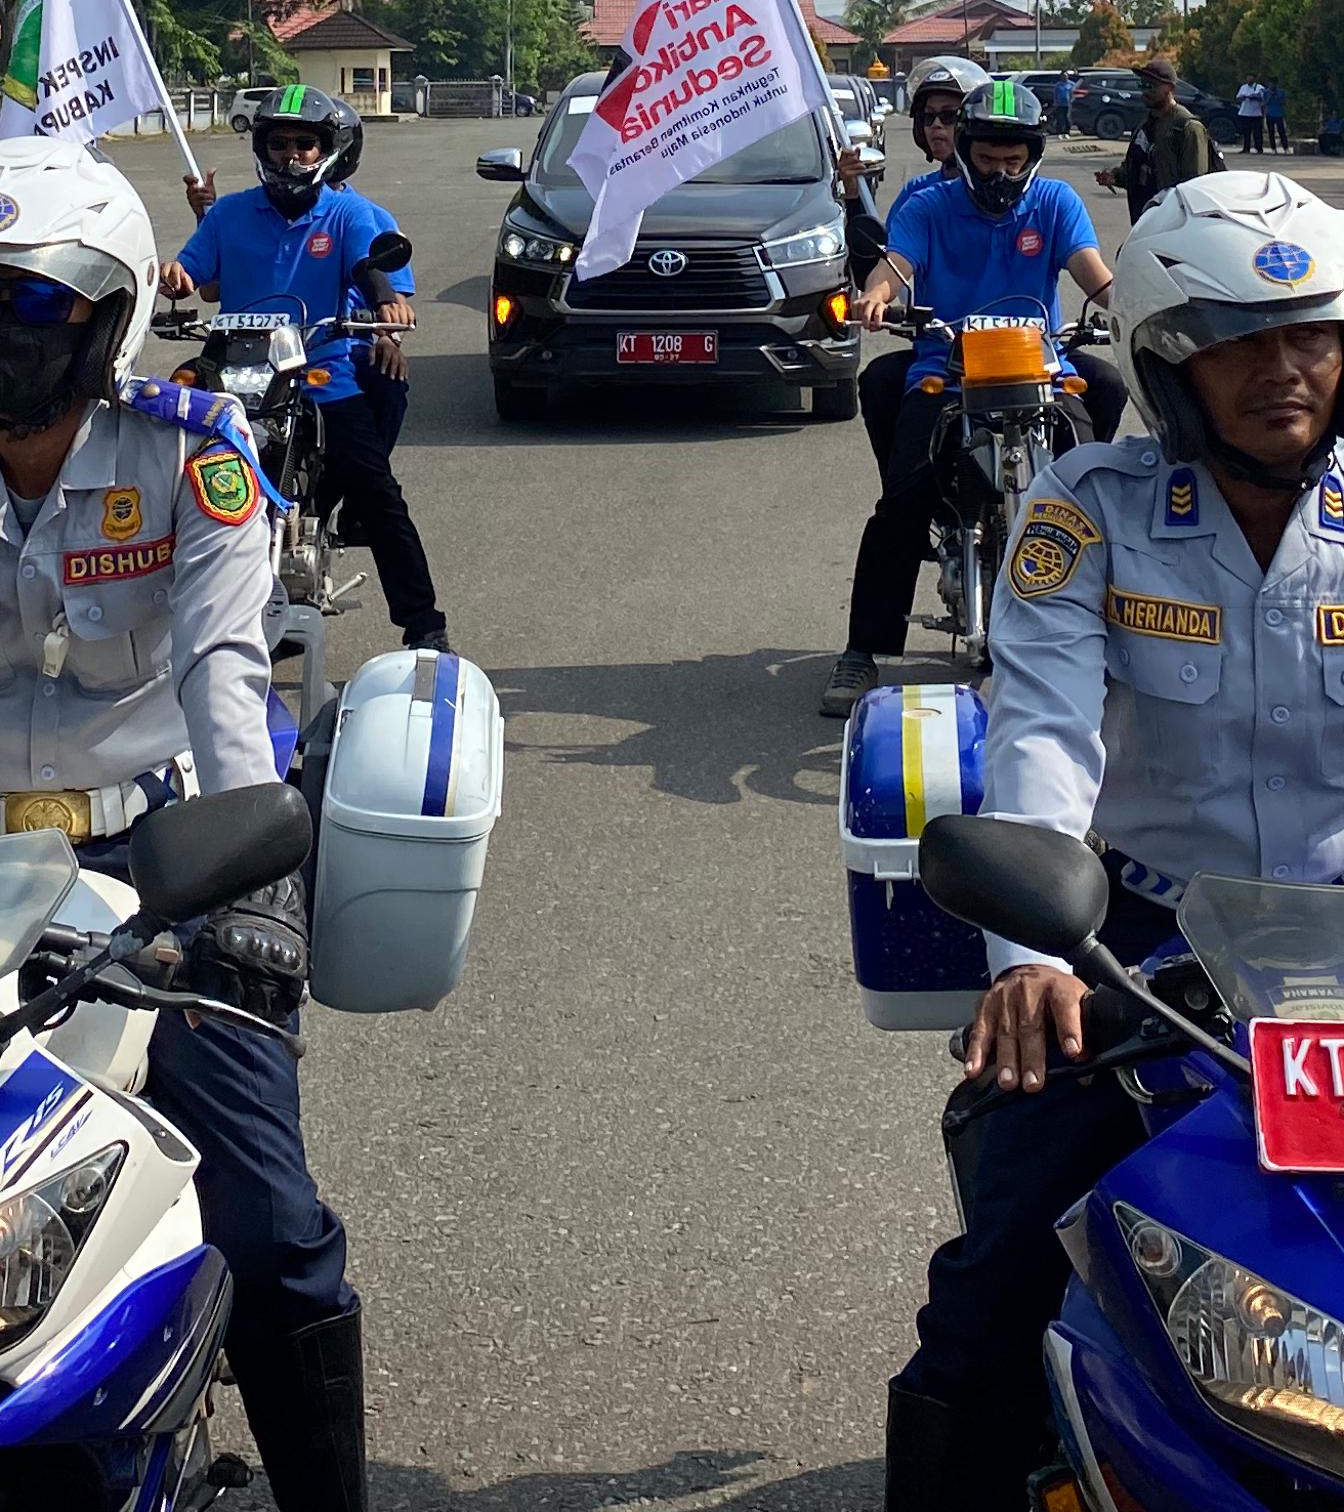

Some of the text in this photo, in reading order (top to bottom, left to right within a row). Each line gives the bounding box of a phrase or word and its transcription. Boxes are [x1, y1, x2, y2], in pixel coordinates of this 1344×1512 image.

[238, 315, 272, 328] 5127
[967, 317, 988, 331] KT
[619, 335, 713, 353] KT 1208 G
[70, 542, 171, 579] DISHUB
[1123, 599, 1211, 637] HERIANDA
[1282, 988, 1334, 999] YAMAHA
